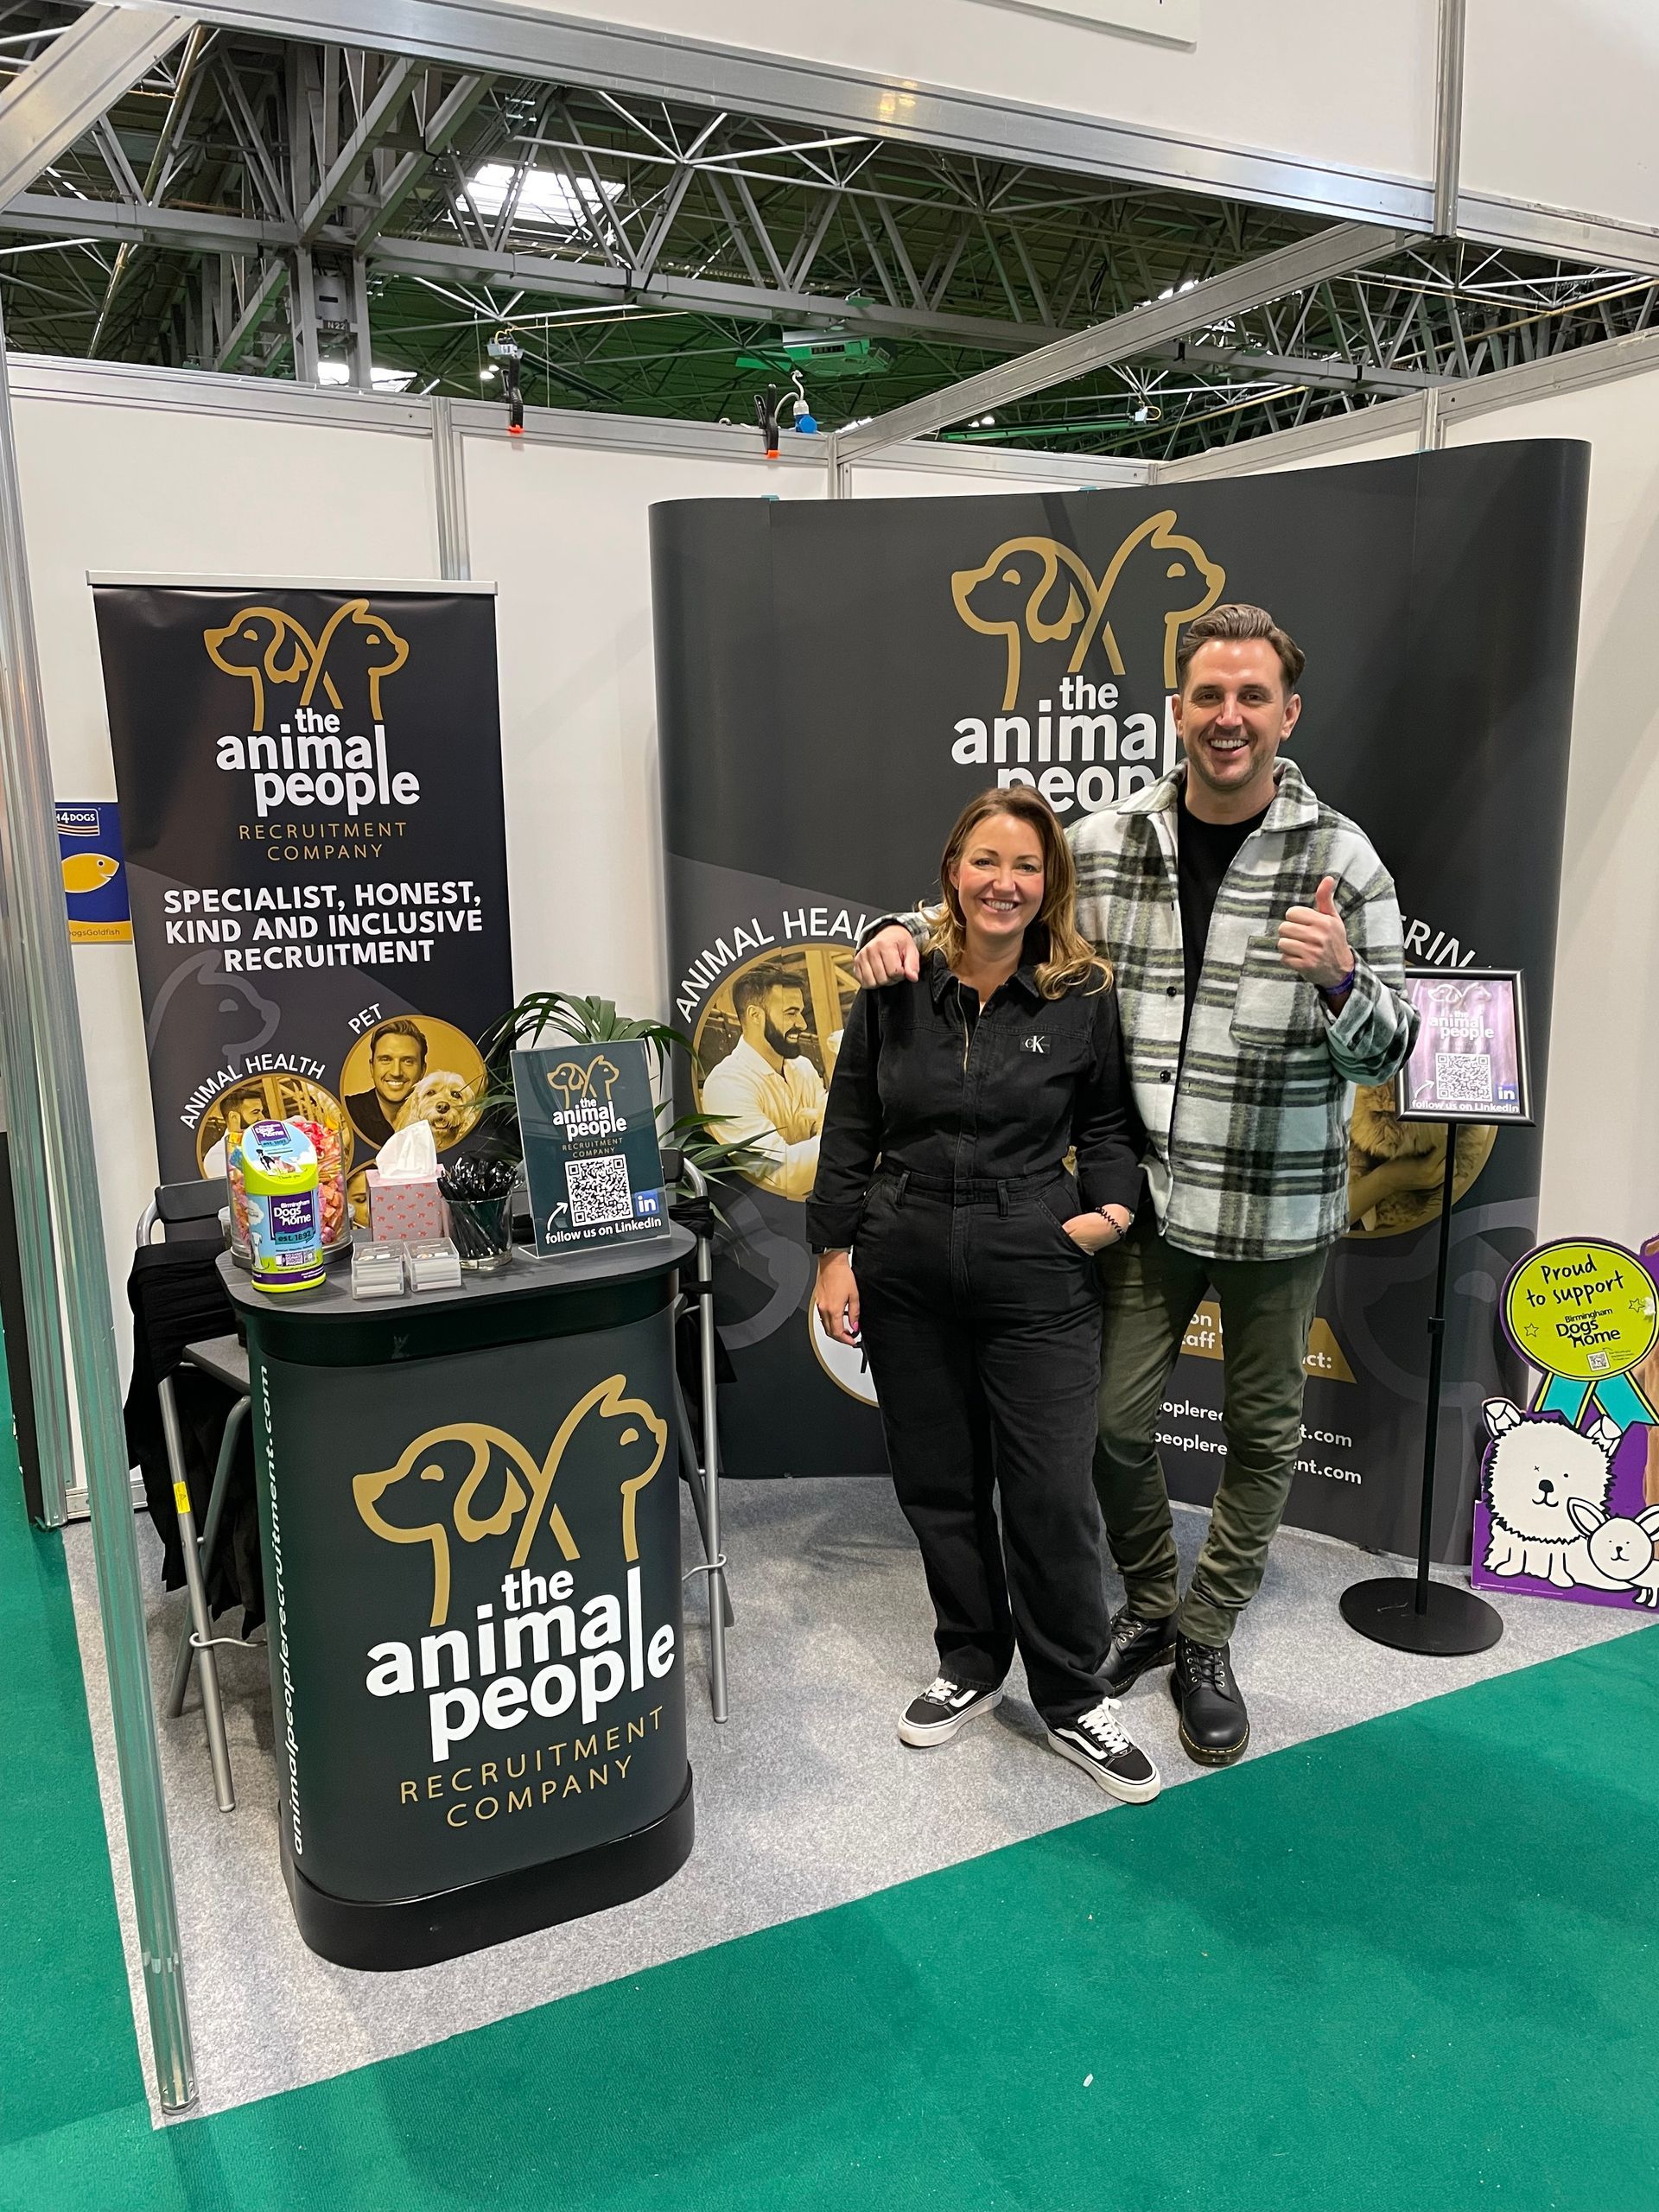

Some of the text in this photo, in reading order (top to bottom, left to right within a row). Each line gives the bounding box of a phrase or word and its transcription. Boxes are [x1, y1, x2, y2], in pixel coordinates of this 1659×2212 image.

[1059, 675, 1119, 710] the
[295, 707, 340, 733] the
[951, 696, 1177, 765] animal
[216, 724, 388, 771] animal
[254, 771, 421, 817] people
[239, 822, 407, 841] RECRUITMENT
[267, 843, 383, 861] COMPANY
[164, 880, 481, 913] SPECIALIST, HONEST,
[69, 929, 120, 938] ogsGoldfish
[165, 909, 483, 944] KIND AND INCLUSIVE
[224, 939, 435, 972] RECRUITMENT
[677, 918, 775, 1023] ANIMAL
[348, 1002, 383, 1035] PET
[1429, 1014, 1484, 1028] animal
[1440, 1026, 1495, 1040] people
[180, 1052, 326, 1130] ANIMAL HEALTH
[580, 1097, 596, 1109] the
[1498, 1087, 1516, 1100] in
[553, 1101, 615, 1126] animal
[1411, 1098, 1445, 1109] follow
[1446, 1102, 1458, 1110] us
[1459, 1103, 1471, 1111] on
[567, 1116, 627, 1141] people
[563, 1138, 623, 1151] RECRUITMENT
[572, 1147, 616, 1159] COMPANY
[274, 1207, 302, 1218] Dogs
[280, 1199, 310, 1209] Birmingham
[637, 1195, 658, 1213] in
[279, 1213, 312, 1226] Home
[545, 1217, 662, 1244] follow us on LinkedIn
[294, 1230, 311, 1241] 1892
[1541, 1253, 1598, 1285] Proud
[1526, 1270, 1624, 1307] to support
[1565, 1307, 1613, 1324] Birmingham
[1555, 1319, 1599, 1338] Dogs
[1567, 1329, 1621, 1349] Home
[1294, 1459, 1362, 1484] nt.com
[501, 1567, 575, 1612] the
[260, 1364, 304, 1856] animalpeoplerecruitment.com
[365, 1567, 644, 1697] animal
[429, 1624, 676, 1764] people
[400, 1706, 663, 1804] RECRUITMENT
[447, 1755, 632, 1827] COMPANY
